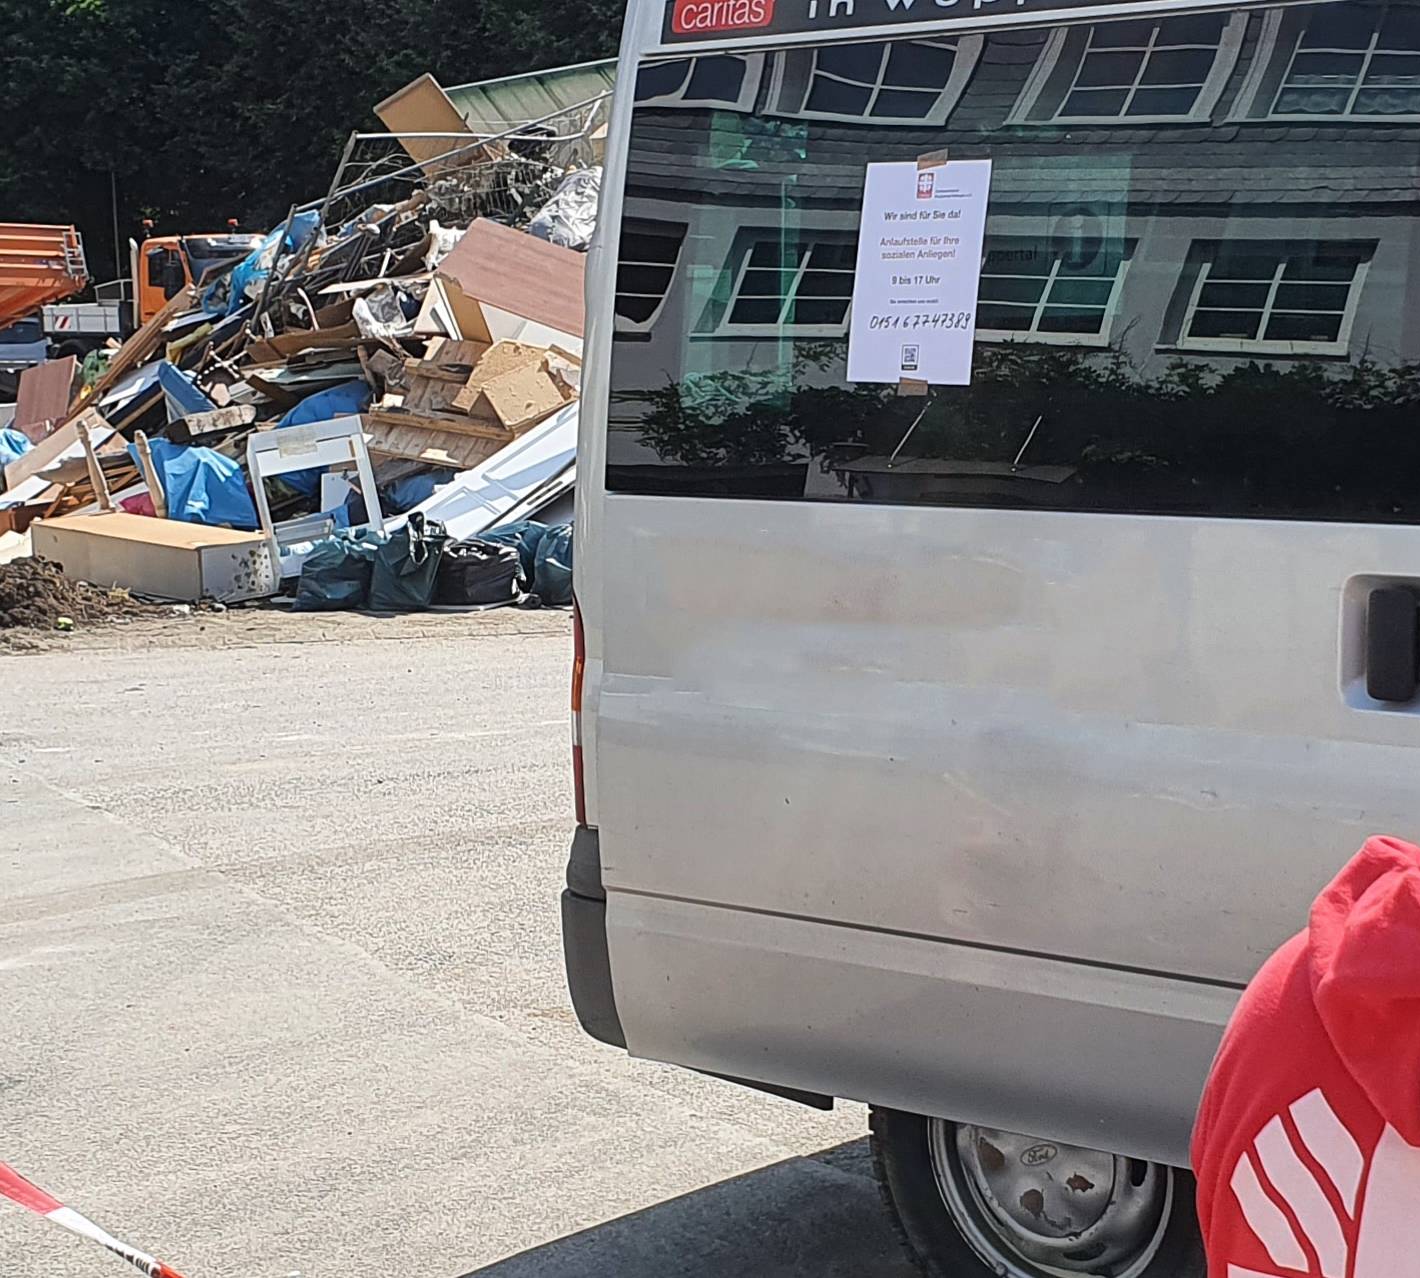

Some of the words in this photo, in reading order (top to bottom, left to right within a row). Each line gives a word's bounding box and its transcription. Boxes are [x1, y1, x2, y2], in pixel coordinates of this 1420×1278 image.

[681, 0, 766, 29] caritas
[884, 211, 898, 221] Wir
[900, 210, 917, 220] sind
[919, 210, 931, 220] für
[933, 209, 946, 219] Sie
[947, 208, 961, 219] da!
[880, 236, 928, 246] Anlaufstelle
[930, 235, 941, 245] für
[881, 250, 915, 260] sozialen
[899, 275, 911, 285] bis
[914, 275, 923, 285] 17
[925, 275, 940, 285] Uhr
